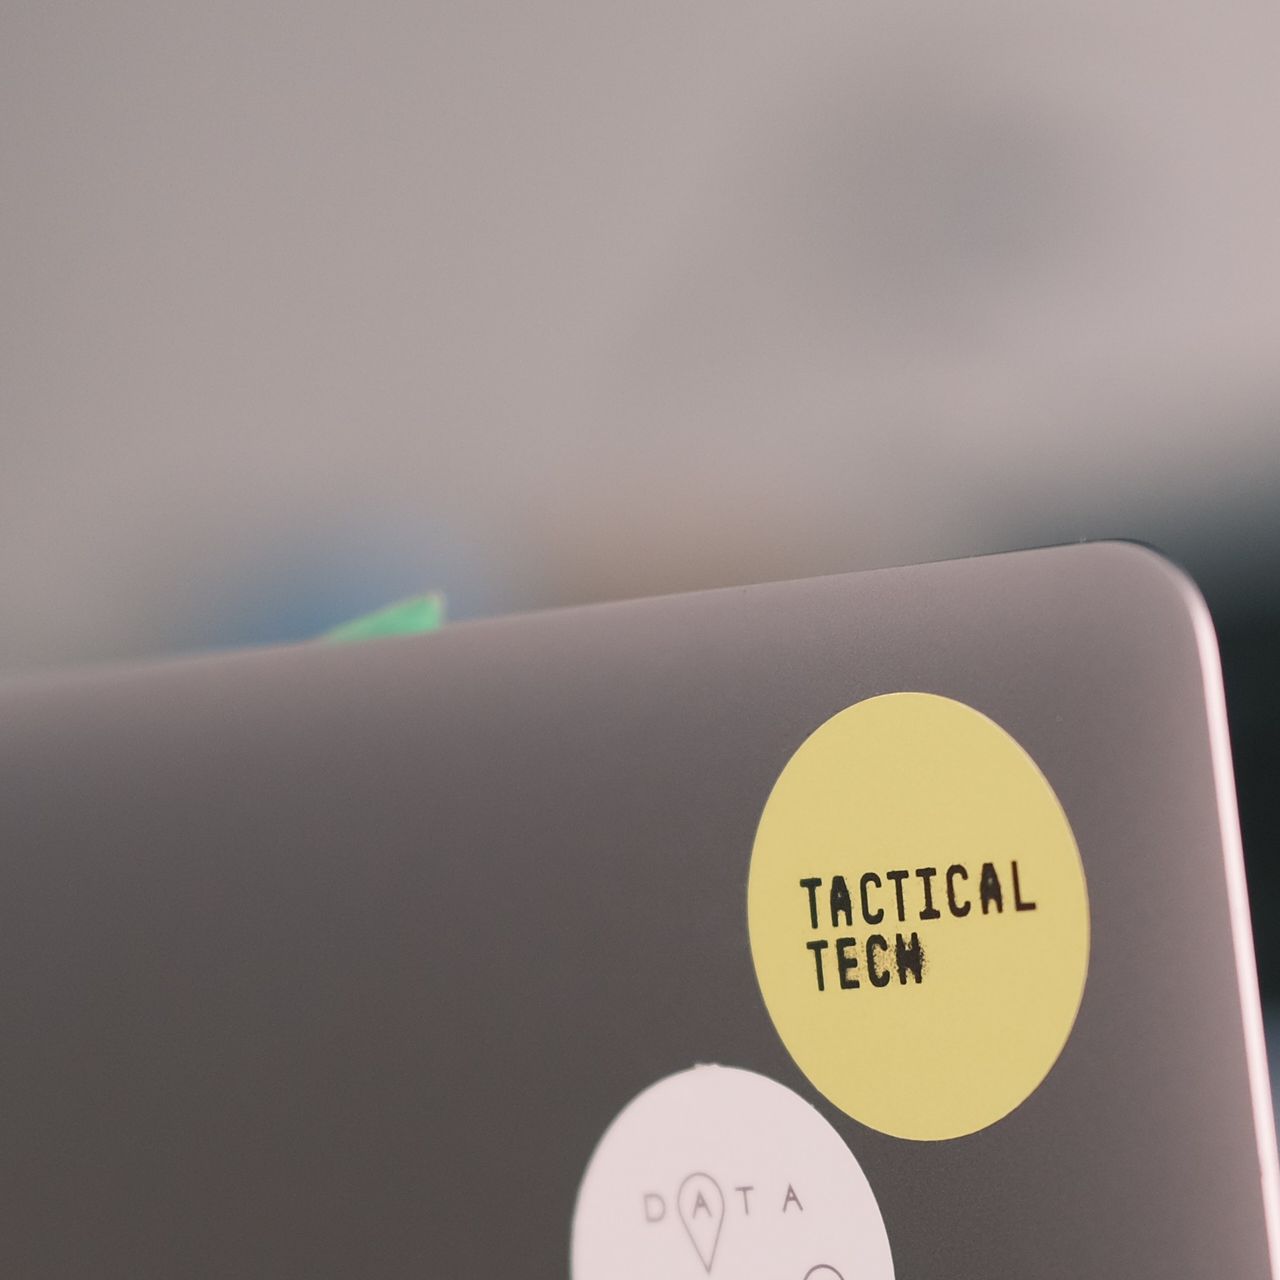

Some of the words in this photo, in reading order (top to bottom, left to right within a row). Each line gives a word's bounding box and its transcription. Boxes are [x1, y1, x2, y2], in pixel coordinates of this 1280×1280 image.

[799, 861, 1037, 930] TACTICAL
[806, 931, 926, 992] TECH
[642, 1184, 804, 1223] DATA
